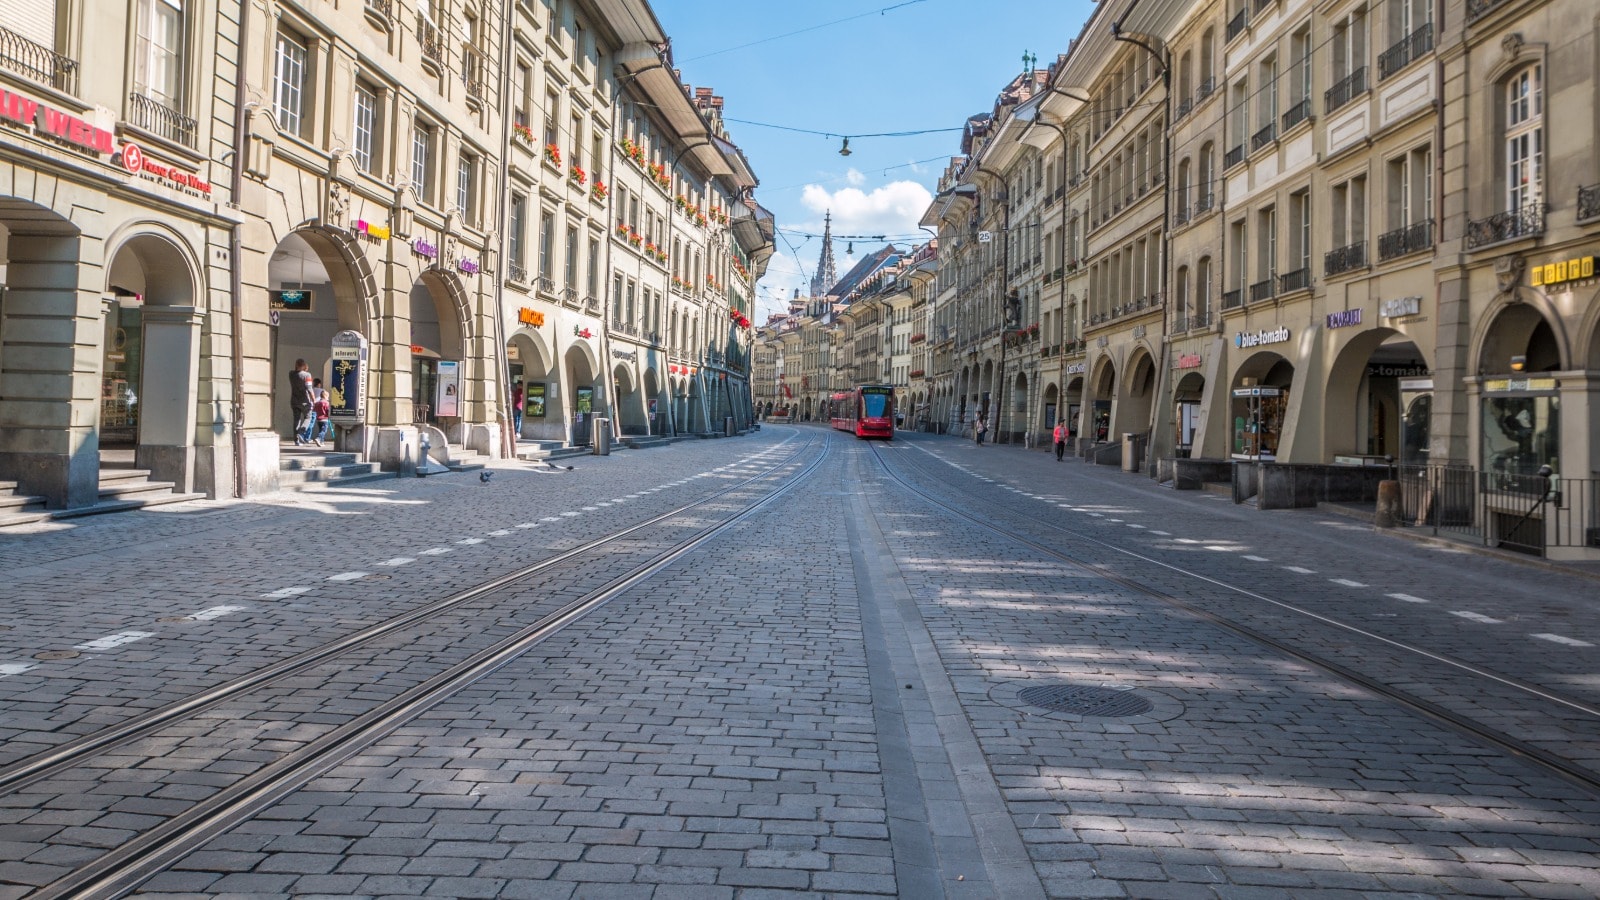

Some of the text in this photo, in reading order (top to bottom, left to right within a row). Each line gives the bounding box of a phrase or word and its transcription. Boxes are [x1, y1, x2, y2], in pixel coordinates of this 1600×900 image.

[979, 232, 990, 241] 25
[1532, 258, 1593, 286] metro
[519, 306, 545, 327] MIGROS
[1241, 325, 1289, 348] blue-tomato
